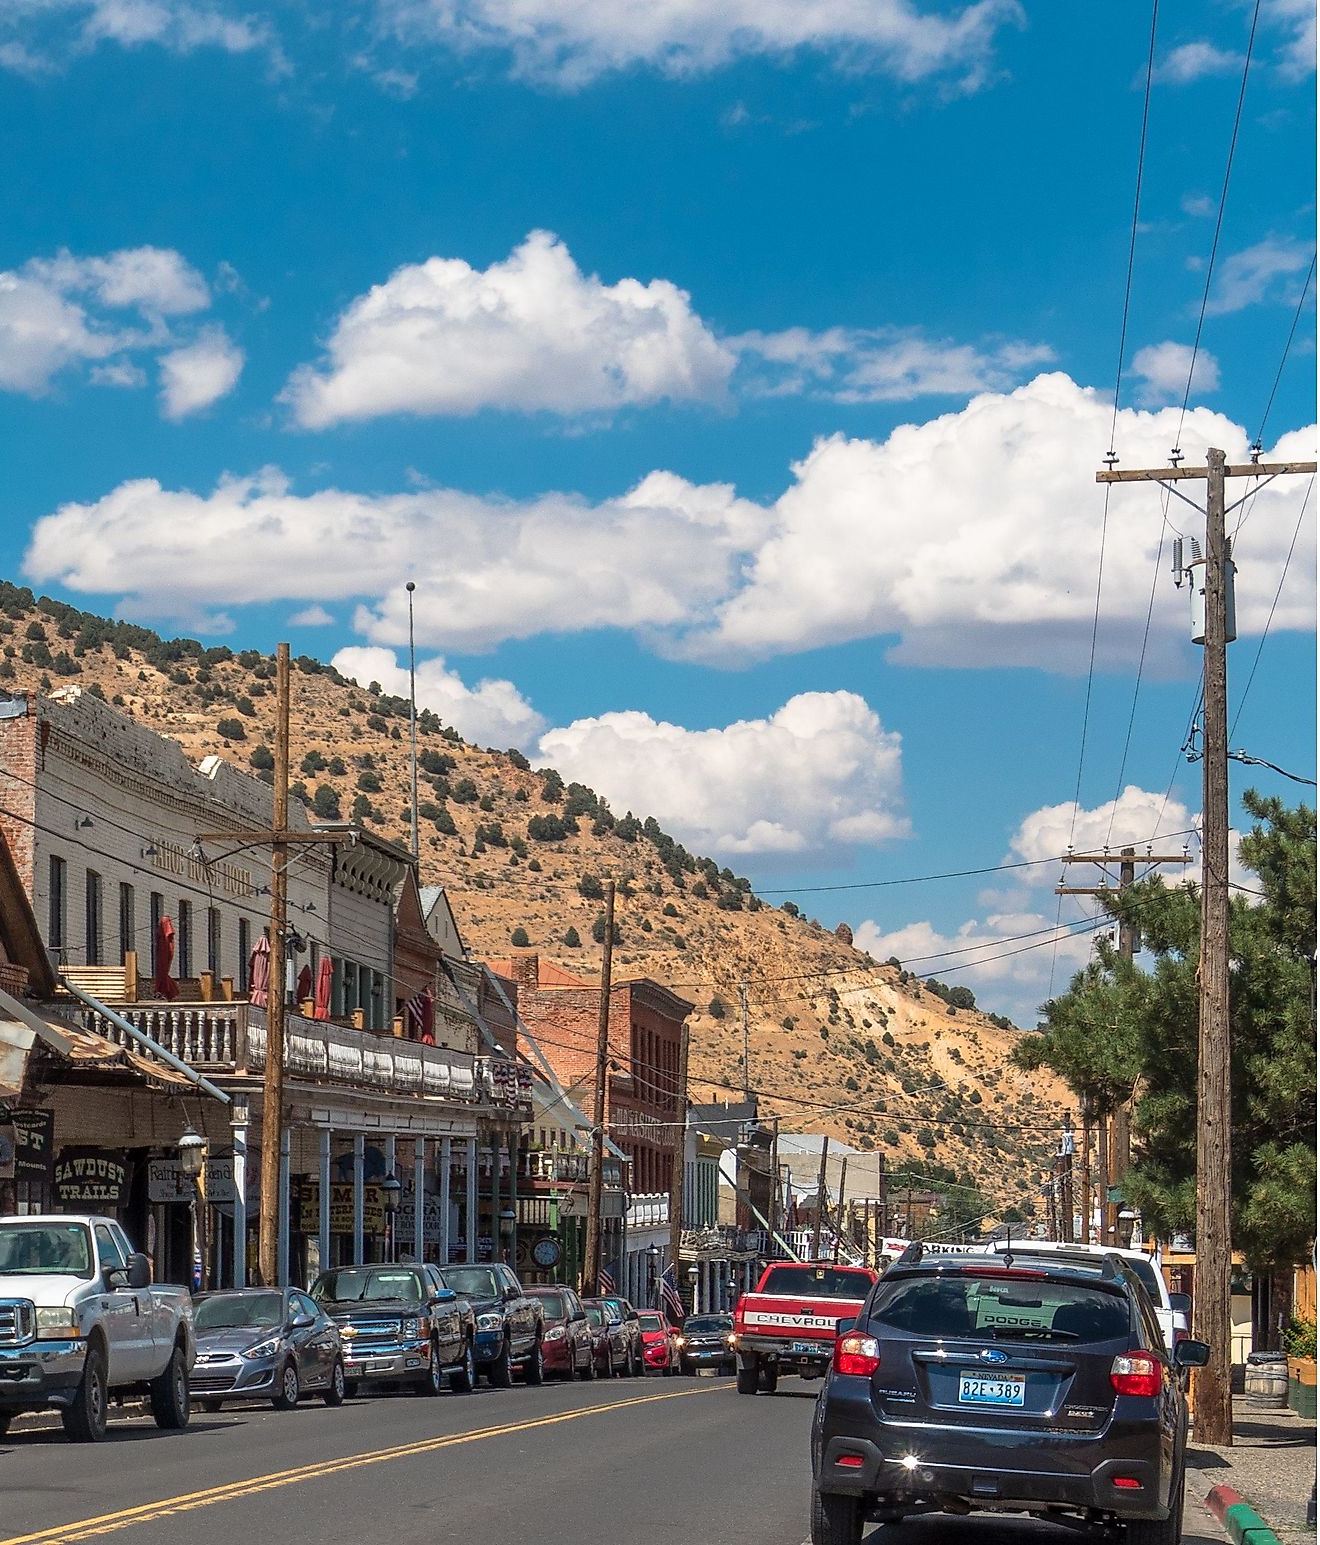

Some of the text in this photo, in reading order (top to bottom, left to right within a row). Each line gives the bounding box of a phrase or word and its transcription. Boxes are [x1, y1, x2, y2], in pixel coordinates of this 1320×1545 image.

[55, 1158, 126, 1185] SAWDUST
[59, 1185, 120, 1200] TRAILS
[922, 1244, 975, 1255] ARKING
[757, 1314, 836, 1328] CHEVROL
[984, 1315, 1042, 1326] DODGE
